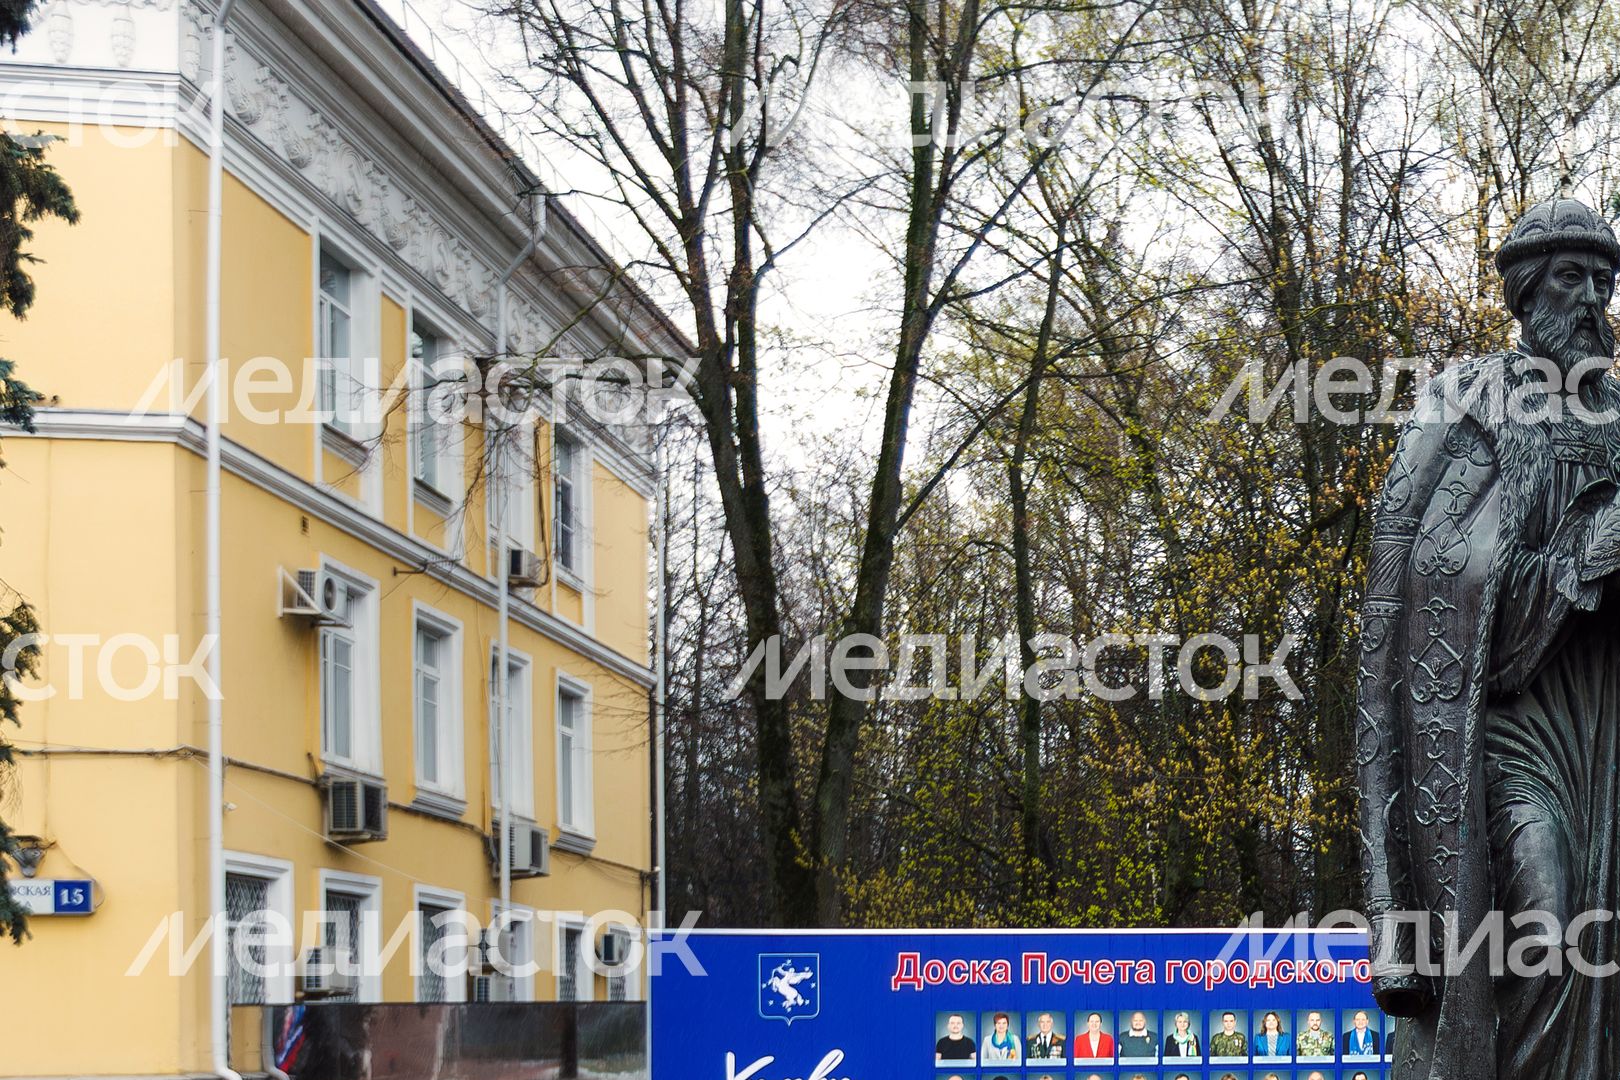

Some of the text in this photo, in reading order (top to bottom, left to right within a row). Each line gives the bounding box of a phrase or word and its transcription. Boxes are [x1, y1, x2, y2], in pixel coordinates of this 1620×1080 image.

[60, 888, 84, 905] 15
[891, 951, 1373, 991] Доска Почета городского
